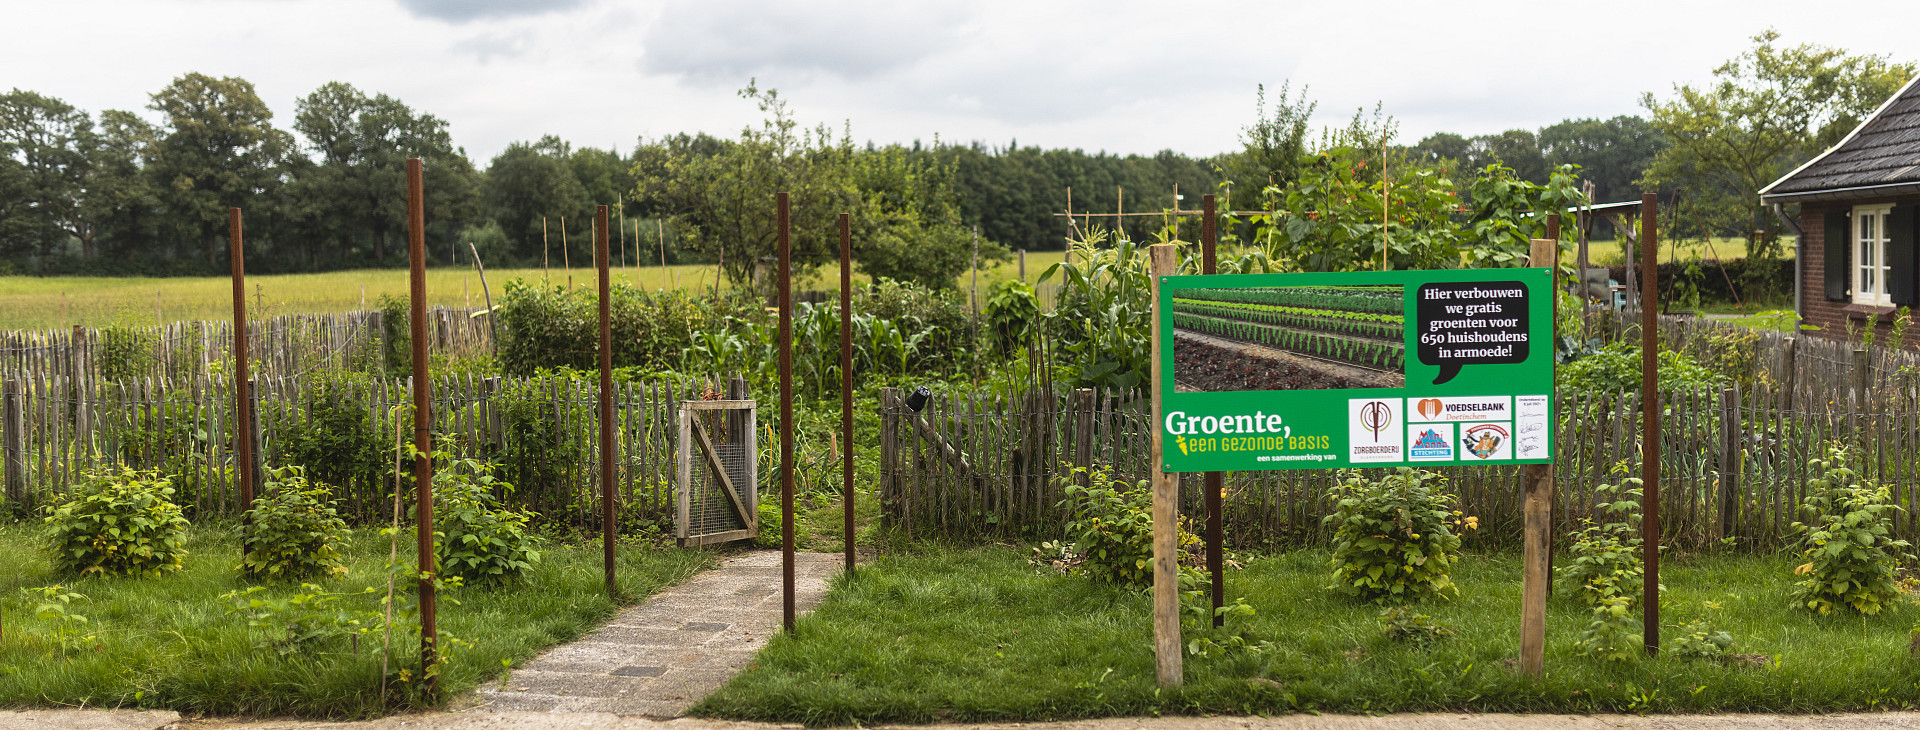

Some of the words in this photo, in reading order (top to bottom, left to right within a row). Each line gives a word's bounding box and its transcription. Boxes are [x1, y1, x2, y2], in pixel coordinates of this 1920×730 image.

[1424, 288, 1452, 300] Hier
[1454, 287, 1523, 299] verbouwen
[1445, 305, 1463, 314] we
[1465, 301, 1502, 317] gratis
[1429, 318, 1487, 332] groenten
[1489, 318, 1518, 328] voor
[1421, 333, 1445, 345] 650
[1447, 331, 1528, 343] huishoudens
[1438, 347, 1452, 358] in
[1454, 345, 1513, 358] armoede!
[1445, 403, 1505, 412] VOEDSELBANK
[1446, 412, 1487, 421] Doetinchem
[1165, 410, 1291, 439] Groente,
[1419, 430, 1443, 440] Mini
[1414, 438, 1448, 448] Manna
[1271, 454, 1323, 462] samenwerking
